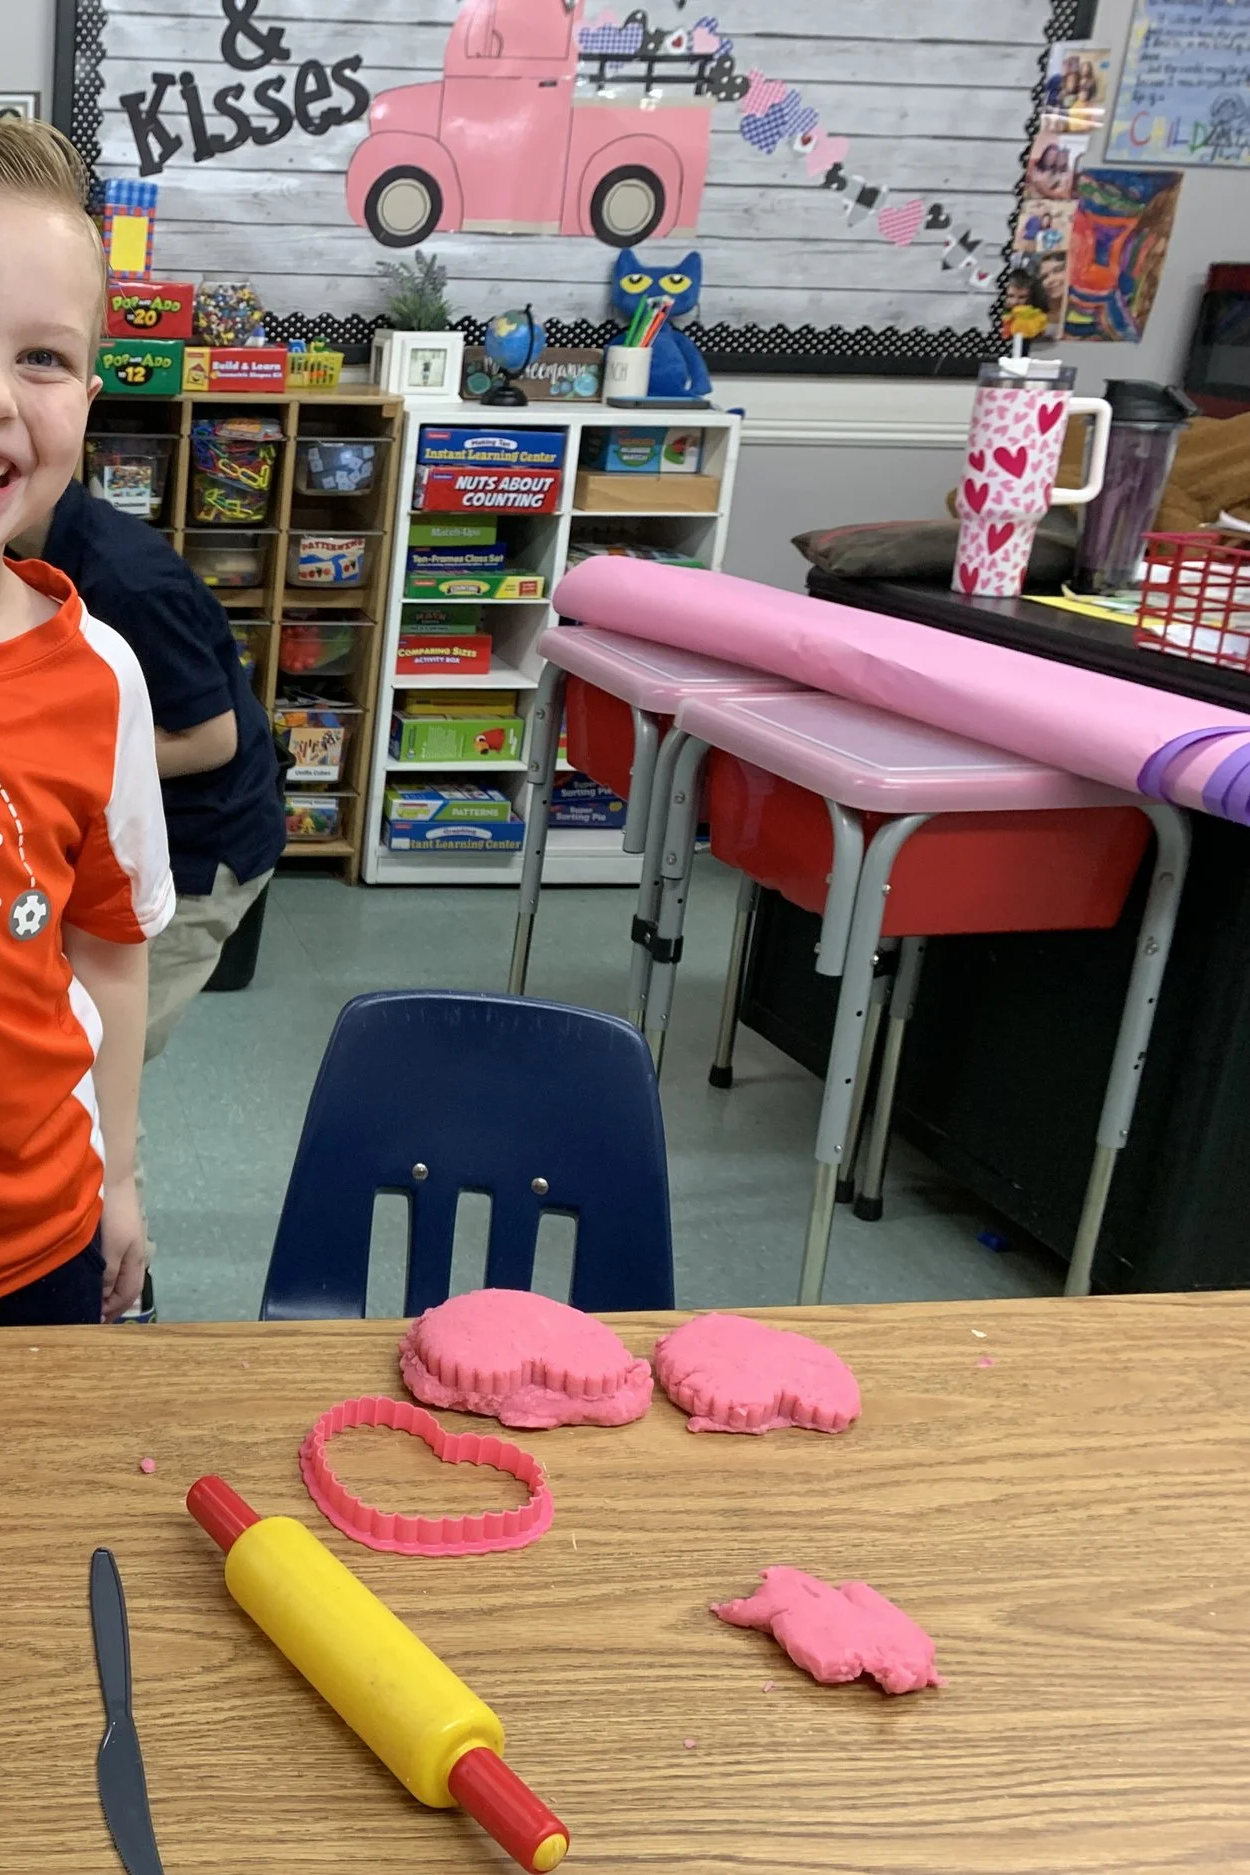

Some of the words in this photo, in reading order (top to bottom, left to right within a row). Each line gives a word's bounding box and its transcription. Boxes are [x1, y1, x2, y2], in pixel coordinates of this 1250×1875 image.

[119, 55, 370, 178] Kisses
[133, 308, 158, 327] 20
[125, 366, 147, 382] 12
[424, 447, 466, 460] Instant
[466, 449, 519, 462] Learning
[519, 451, 557, 463] Center
[454, 475, 498, 490] NUTS
[497, 476, 555, 492] ABOUT
[461, 492, 545, 508] COUNTING
[397, 646, 451, 658] COMPARING
[451, 807, 499, 818] PATTERNS
